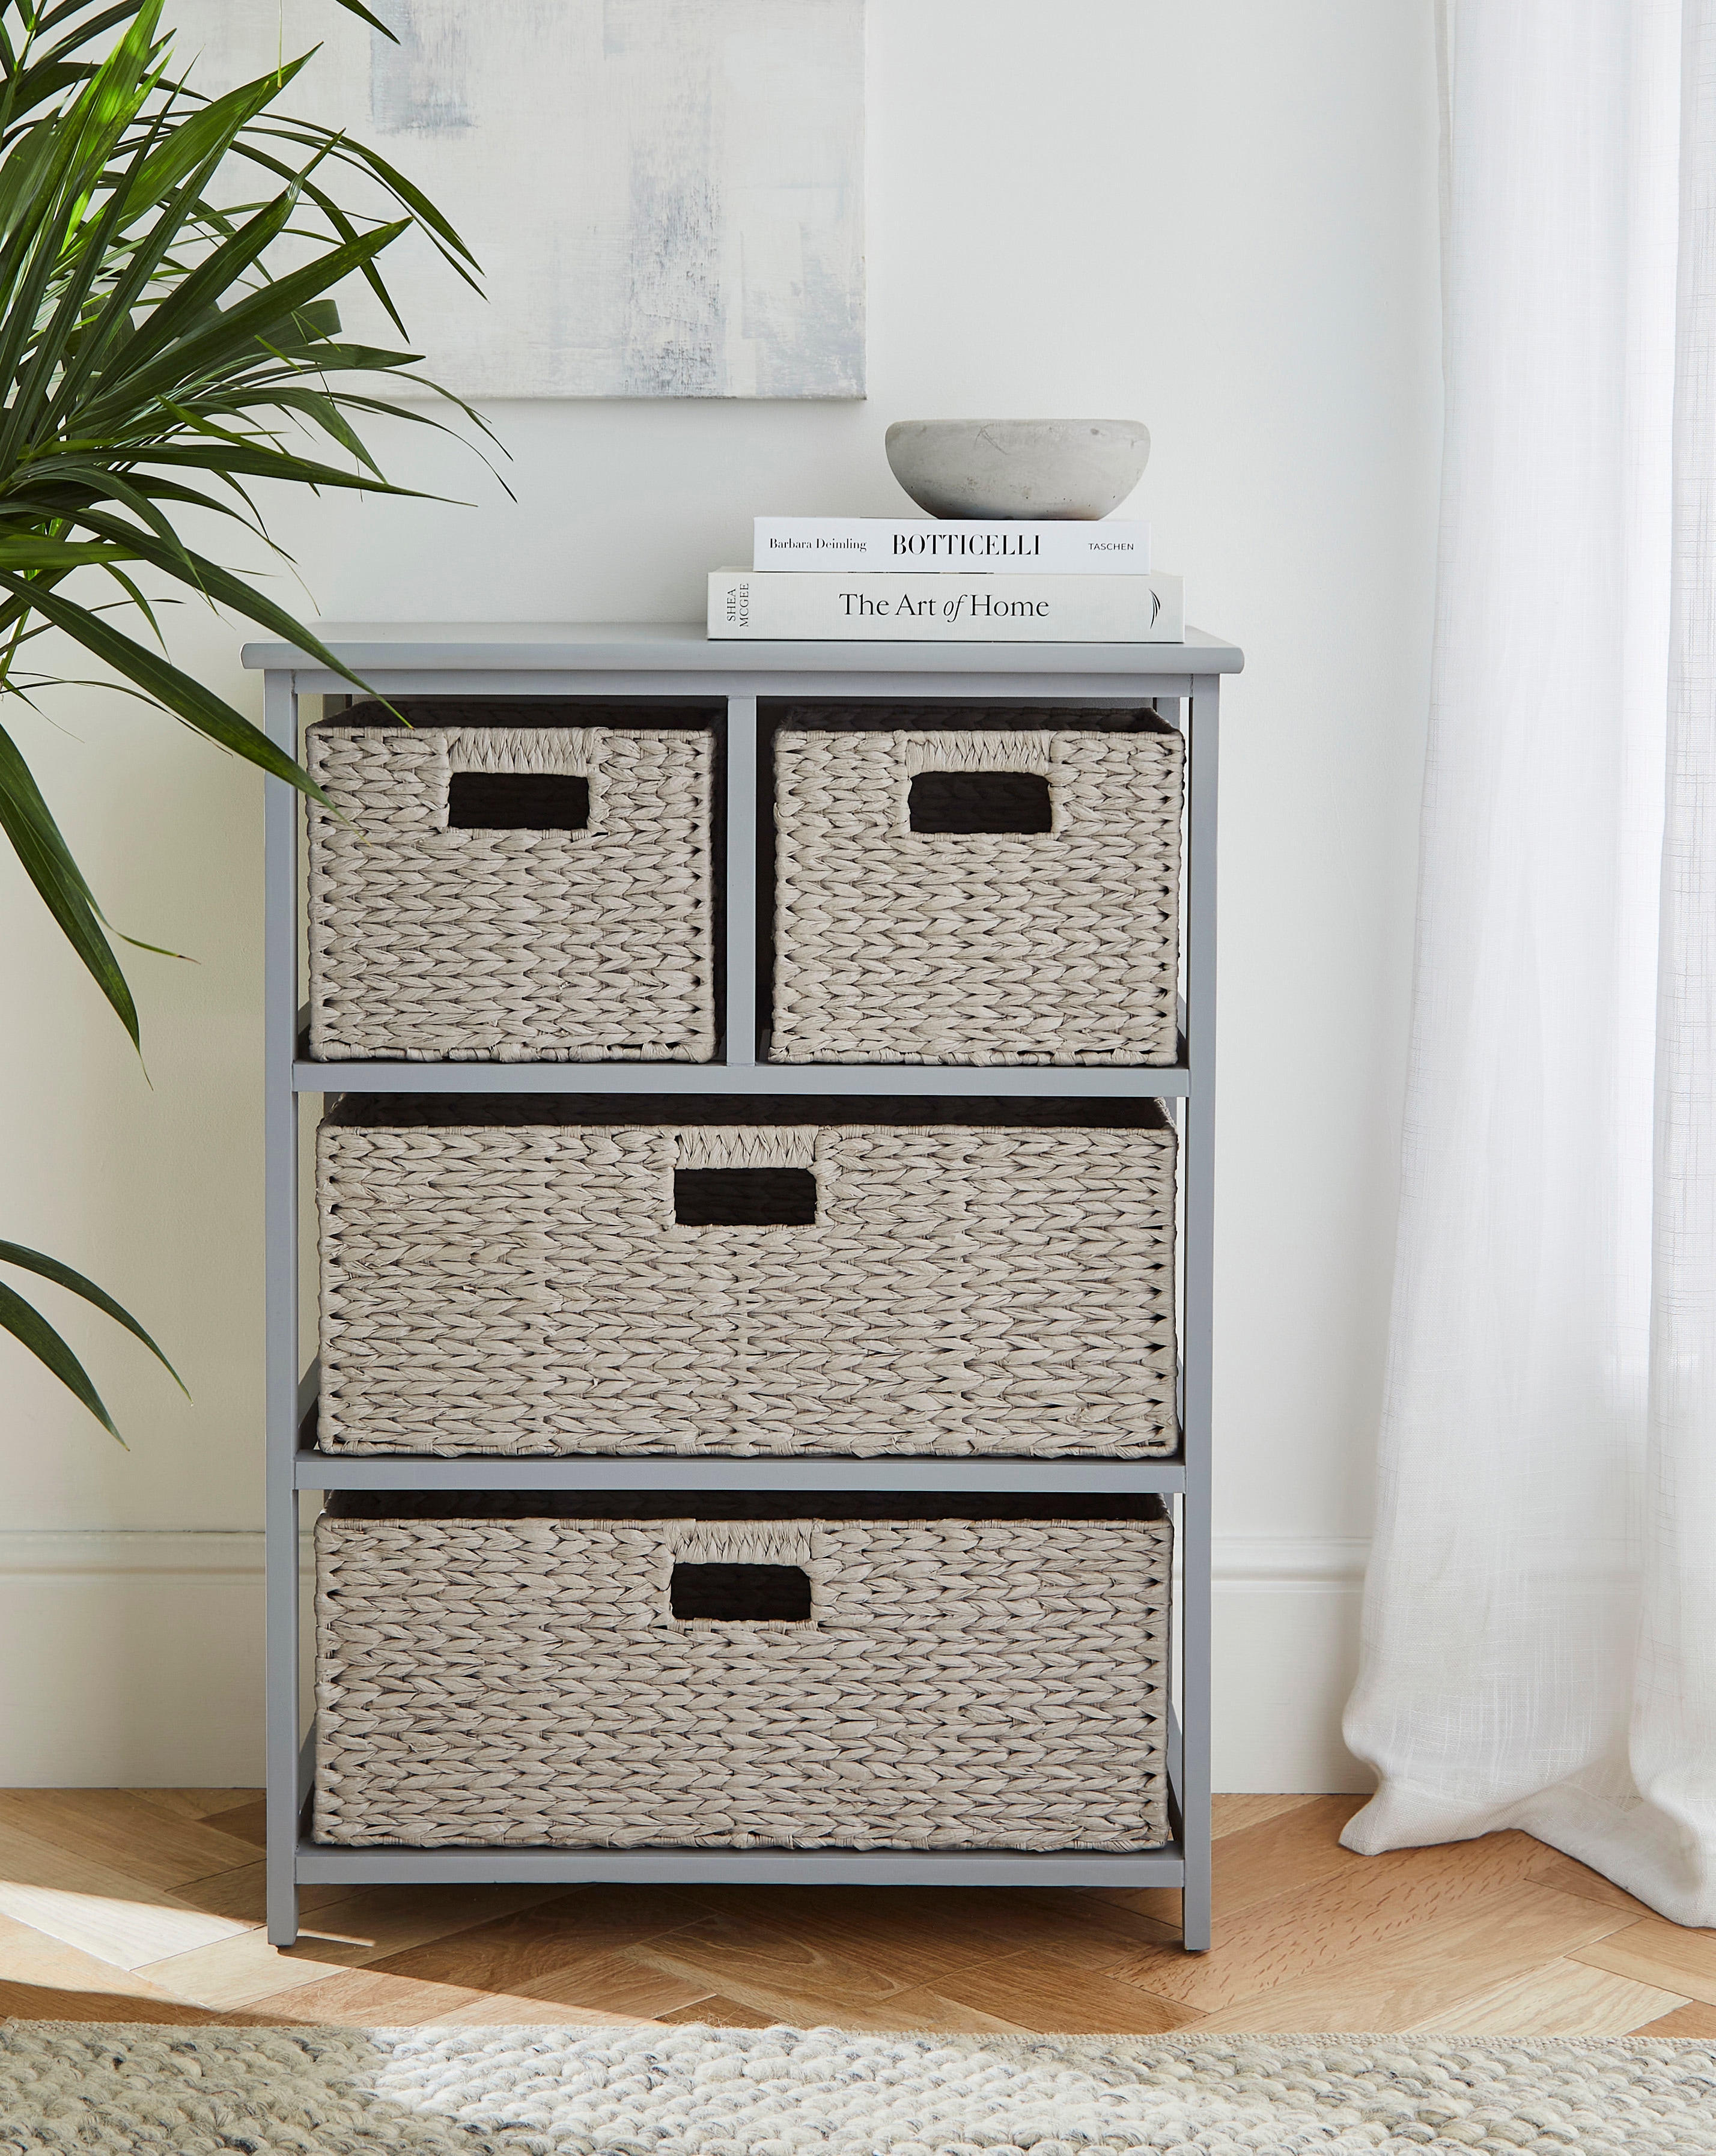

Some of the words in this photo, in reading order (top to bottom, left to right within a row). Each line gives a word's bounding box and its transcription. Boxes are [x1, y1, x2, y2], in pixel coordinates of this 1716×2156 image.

[770, 538, 812, 548] Barbara
[816, 538, 867, 553] Deimling
[893, 534, 1039, 556] BOTTICELLI
[1088, 542, 1134, 551] TASCHEN
[726, 588, 736, 622] SHEA
[739, 583, 749, 627] MCGEE
[838, 593, 890, 616] The
[894, 594, 937, 616] Art
[943, 594, 968, 623] of
[970, 594, 1049, 617] Home
